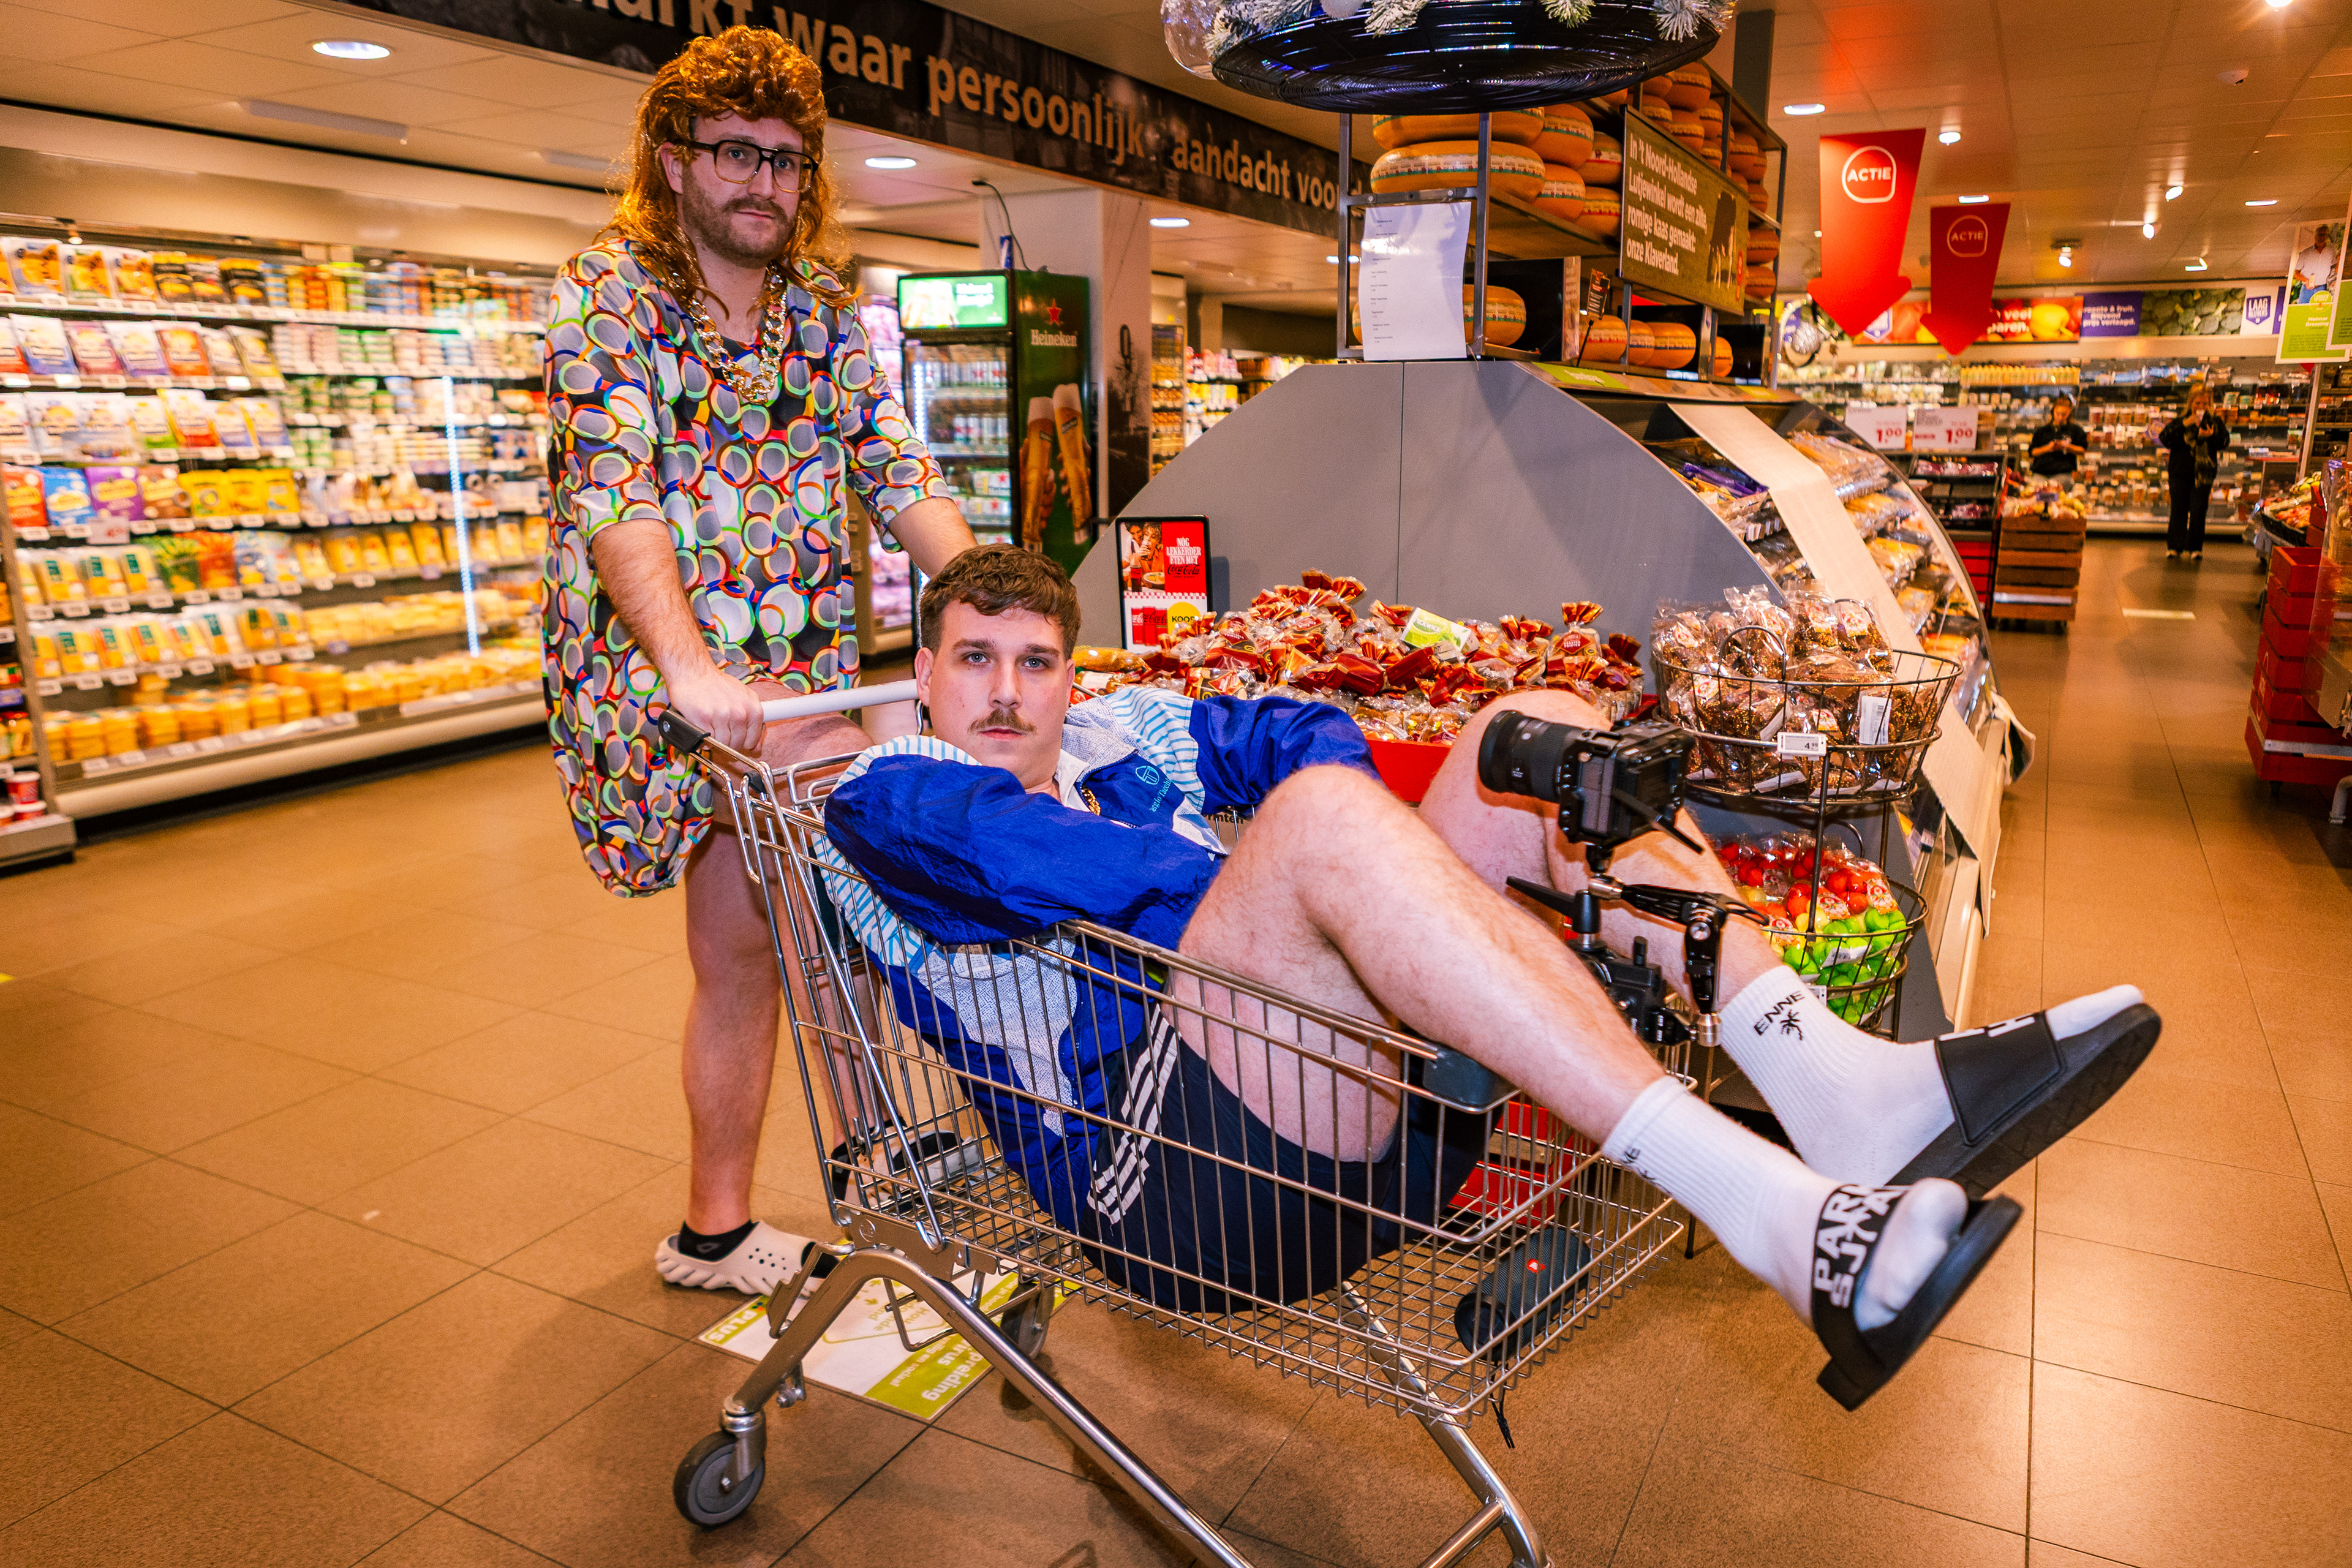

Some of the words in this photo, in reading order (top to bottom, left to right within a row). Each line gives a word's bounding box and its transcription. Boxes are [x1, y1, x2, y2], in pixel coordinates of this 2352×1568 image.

[772, 5, 911, 90] waar
[1172, 133, 1291, 199] aandacht
[1629, 132, 1638, 162] In
[1645, 143, 1697, 196] Noord-Hollandse
[1847, 167, 1891, 183] ACTIE
[1629, 166, 1666, 209] Lutjewinkel
[1667, 192, 1684, 218] wordt
[1685, 203, 1695, 224] een
[1627, 205, 1653, 236] romige
[1654, 211, 1668, 241] kaas
[1669, 225, 1696, 253] gemaakt:
[1951, 230, 1984, 242] ACTIE
[1627, 238, 1645, 263] onze
[1645, 240, 1679, 276] Klaverland.
[2248, 298, 2268, 310] LAAG
[1031, 329, 1077, 347] Heineken
[1986, 322, 2030, 334] paren.
[1166, 546, 1202, 557] LEKKERDER
[1170, 555, 1185, 565] ETEN
[1185, 555, 1199, 565] MET
[1414, 616, 1443, 633] PICKWICK
[1149, 791, 1163, 813] ergio
[1203, 813, 1244, 824] rinten
[1754, 990, 1805, 1036] ENNE
[708, 1310, 758, 1341] PLUS
[921, 1351, 984, 1401] preiding
